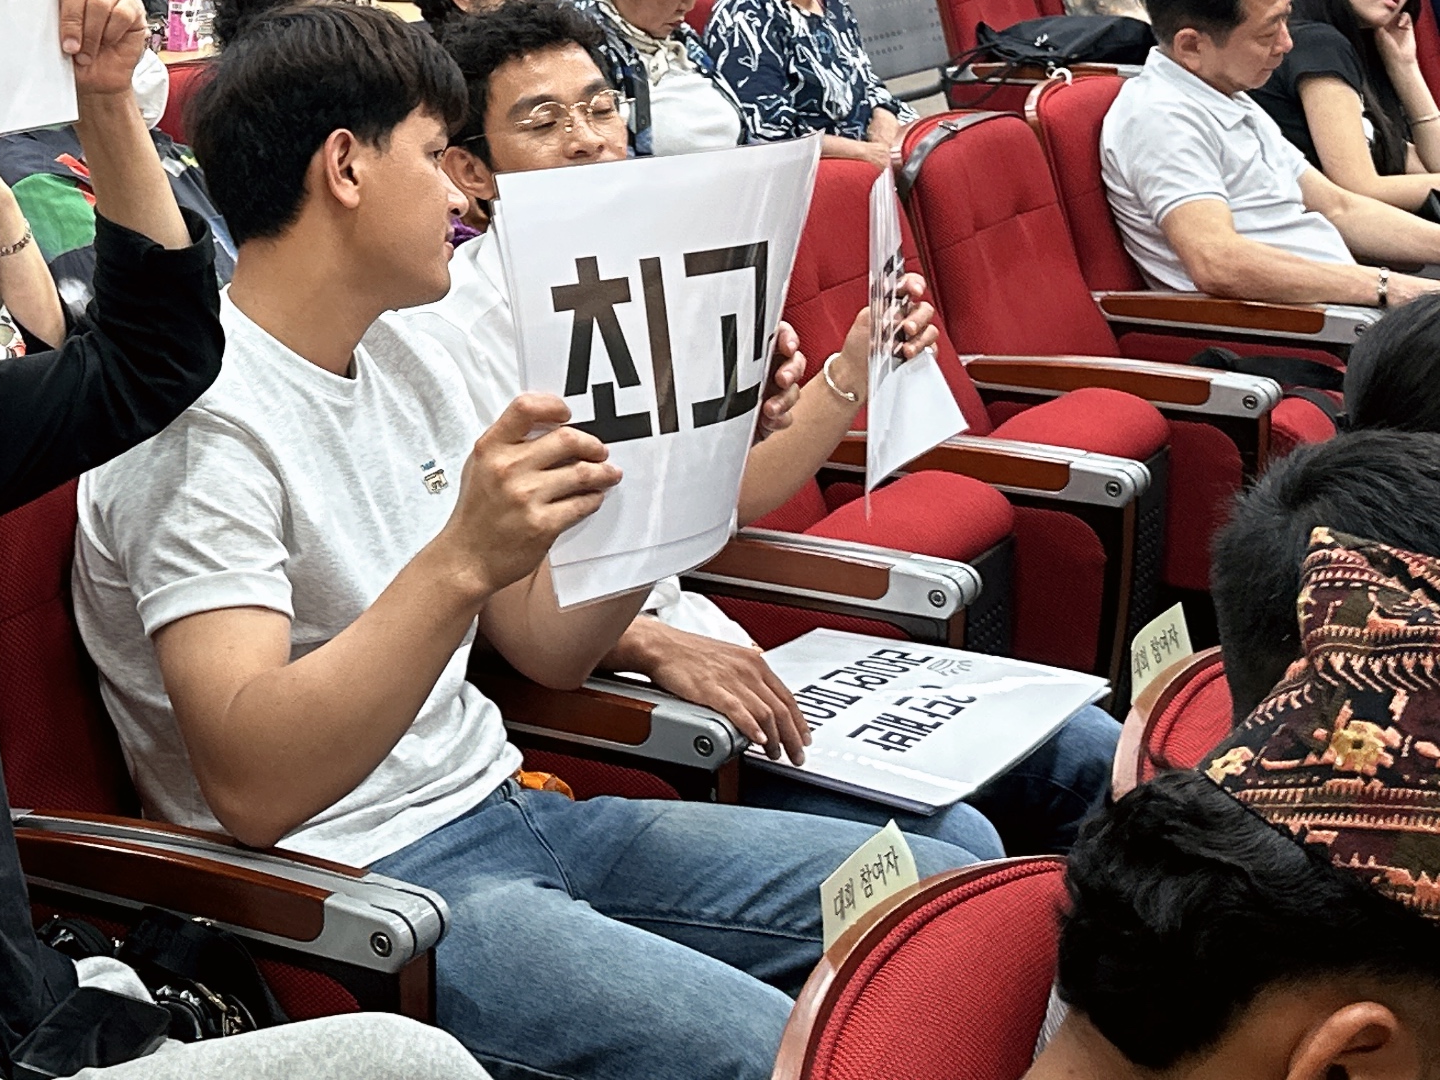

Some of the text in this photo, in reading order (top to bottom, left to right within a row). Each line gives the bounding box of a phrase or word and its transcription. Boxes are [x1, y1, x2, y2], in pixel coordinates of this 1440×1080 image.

[550, 240, 768, 444] 최고
[1150, 623, 1180, 664] 참여자
[793, 648, 935, 733] 라이언 파이
[833, 845, 900, 920] 대회 참여자
